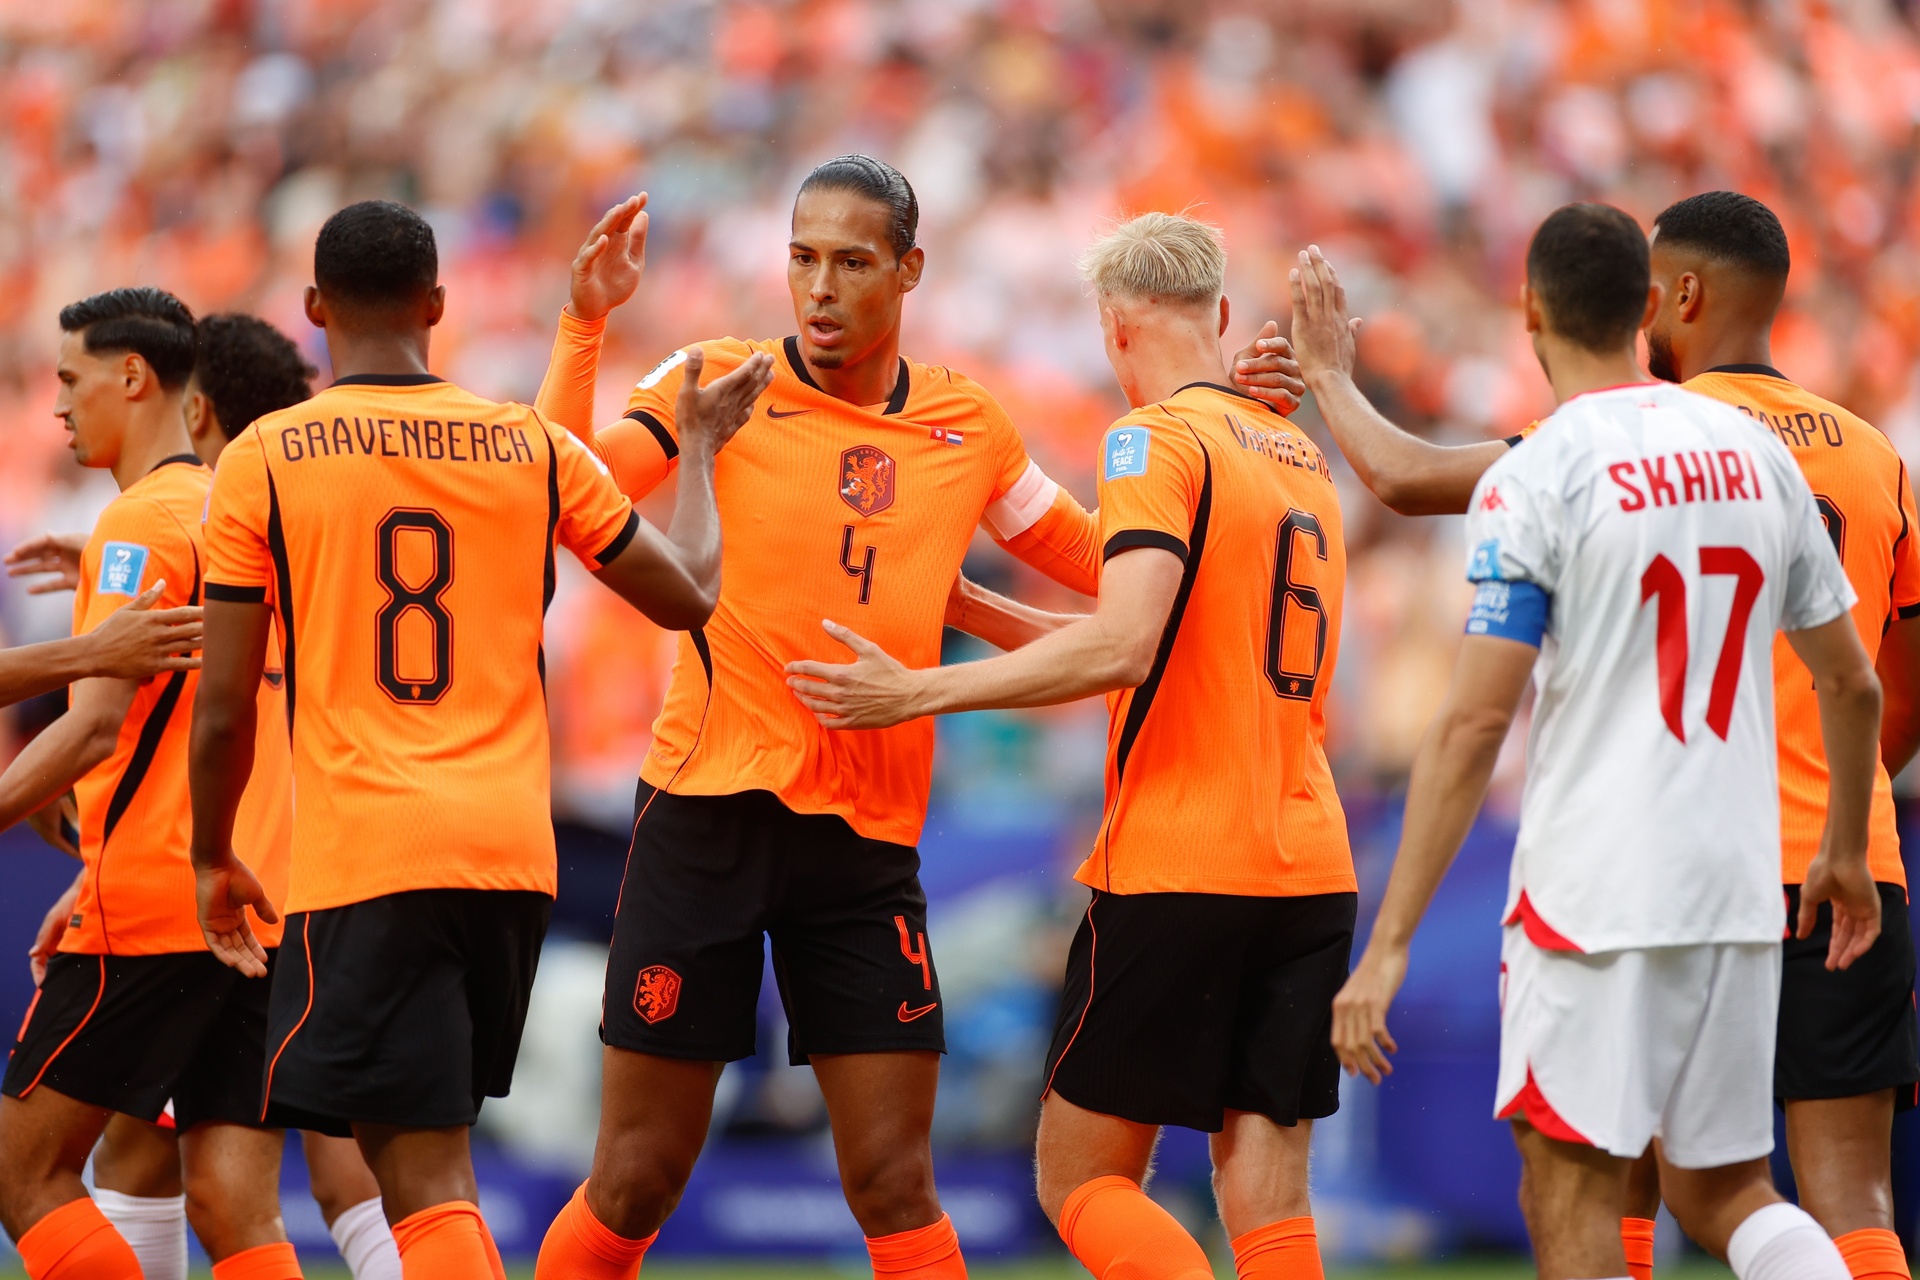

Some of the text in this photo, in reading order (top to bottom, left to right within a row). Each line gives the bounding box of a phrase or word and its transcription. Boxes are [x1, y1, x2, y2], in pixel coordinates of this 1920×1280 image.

[281, 417, 534, 463] GRAVENBERCH
[1608, 450, 1763, 513] SKHIRI
[839, 524, 877, 605] 4
[1263, 507, 1328, 702] 6
[375, 506, 454, 706] 8
[1638, 546, 1765, 746] 17
[894, 915, 932, 990] 4
